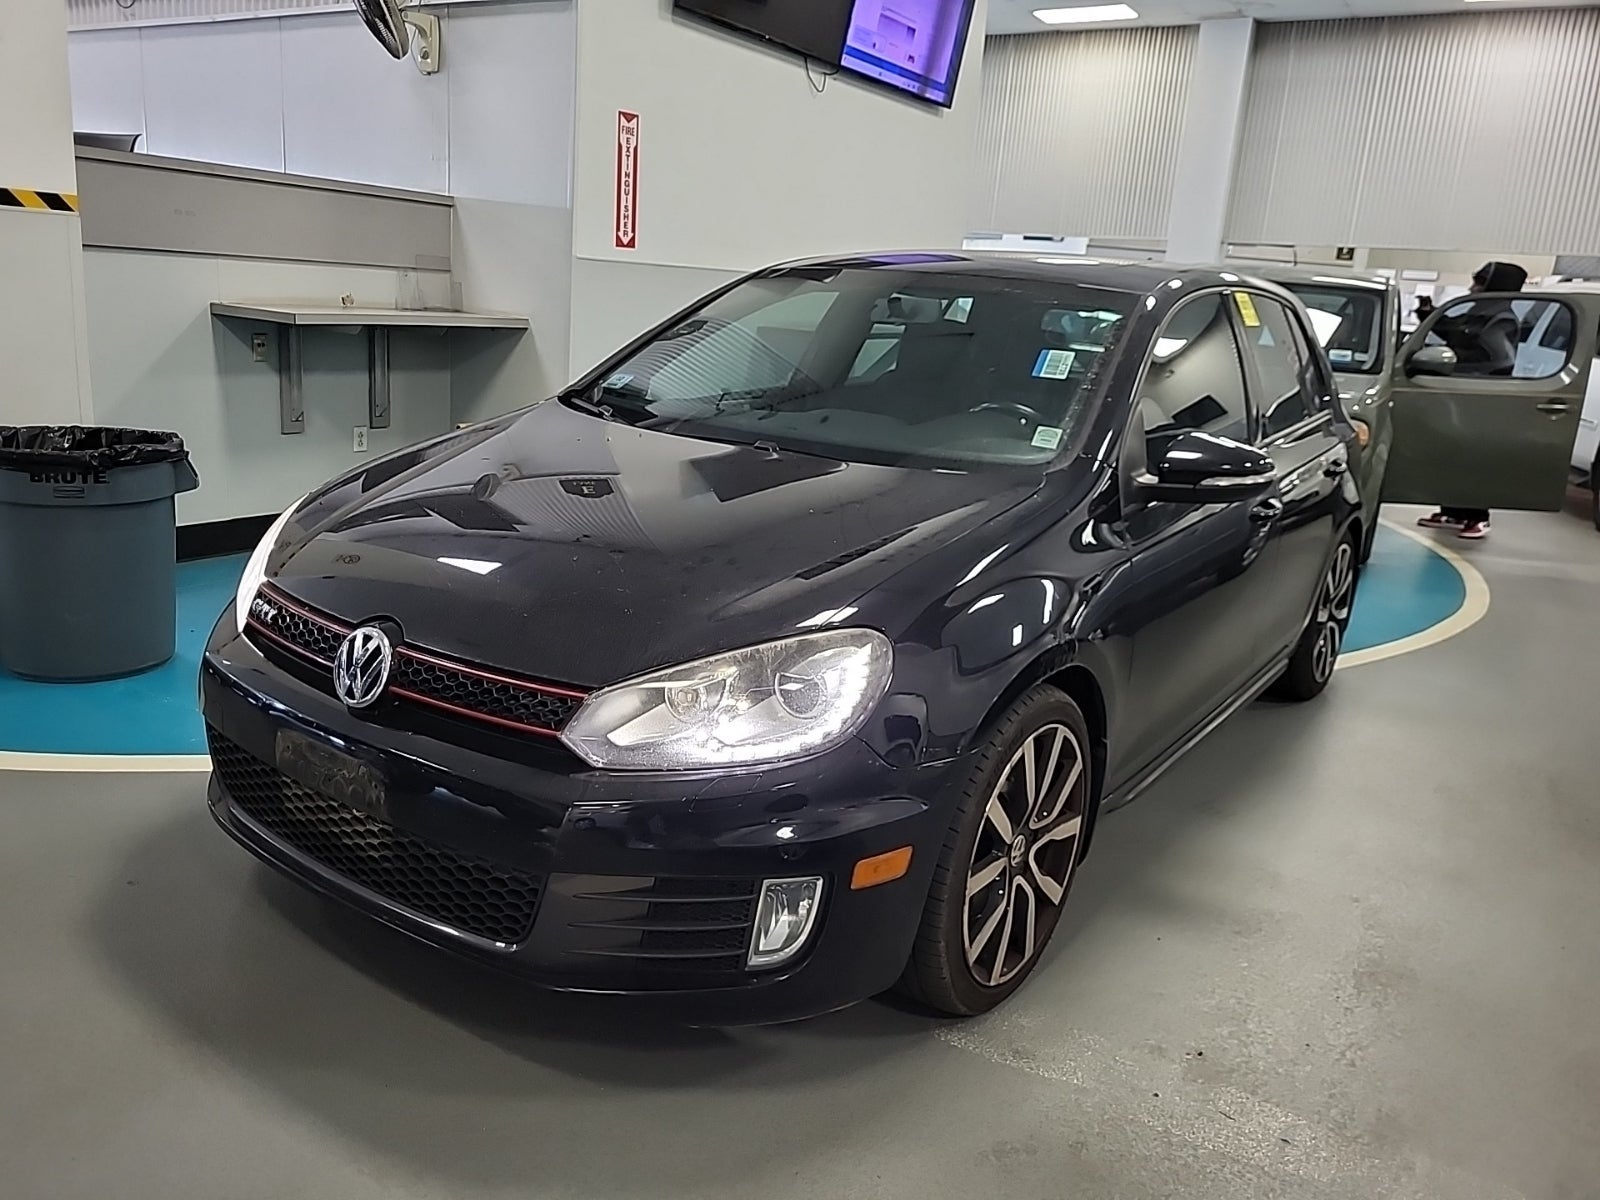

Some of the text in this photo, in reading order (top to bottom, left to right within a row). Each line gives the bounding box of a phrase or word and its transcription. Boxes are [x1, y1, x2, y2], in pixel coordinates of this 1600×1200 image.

[621, 125, 635, 137] FIRE
[623, 137, 631, 238] EXTINGUISHER
[29, 471, 108, 485] BRUTE
